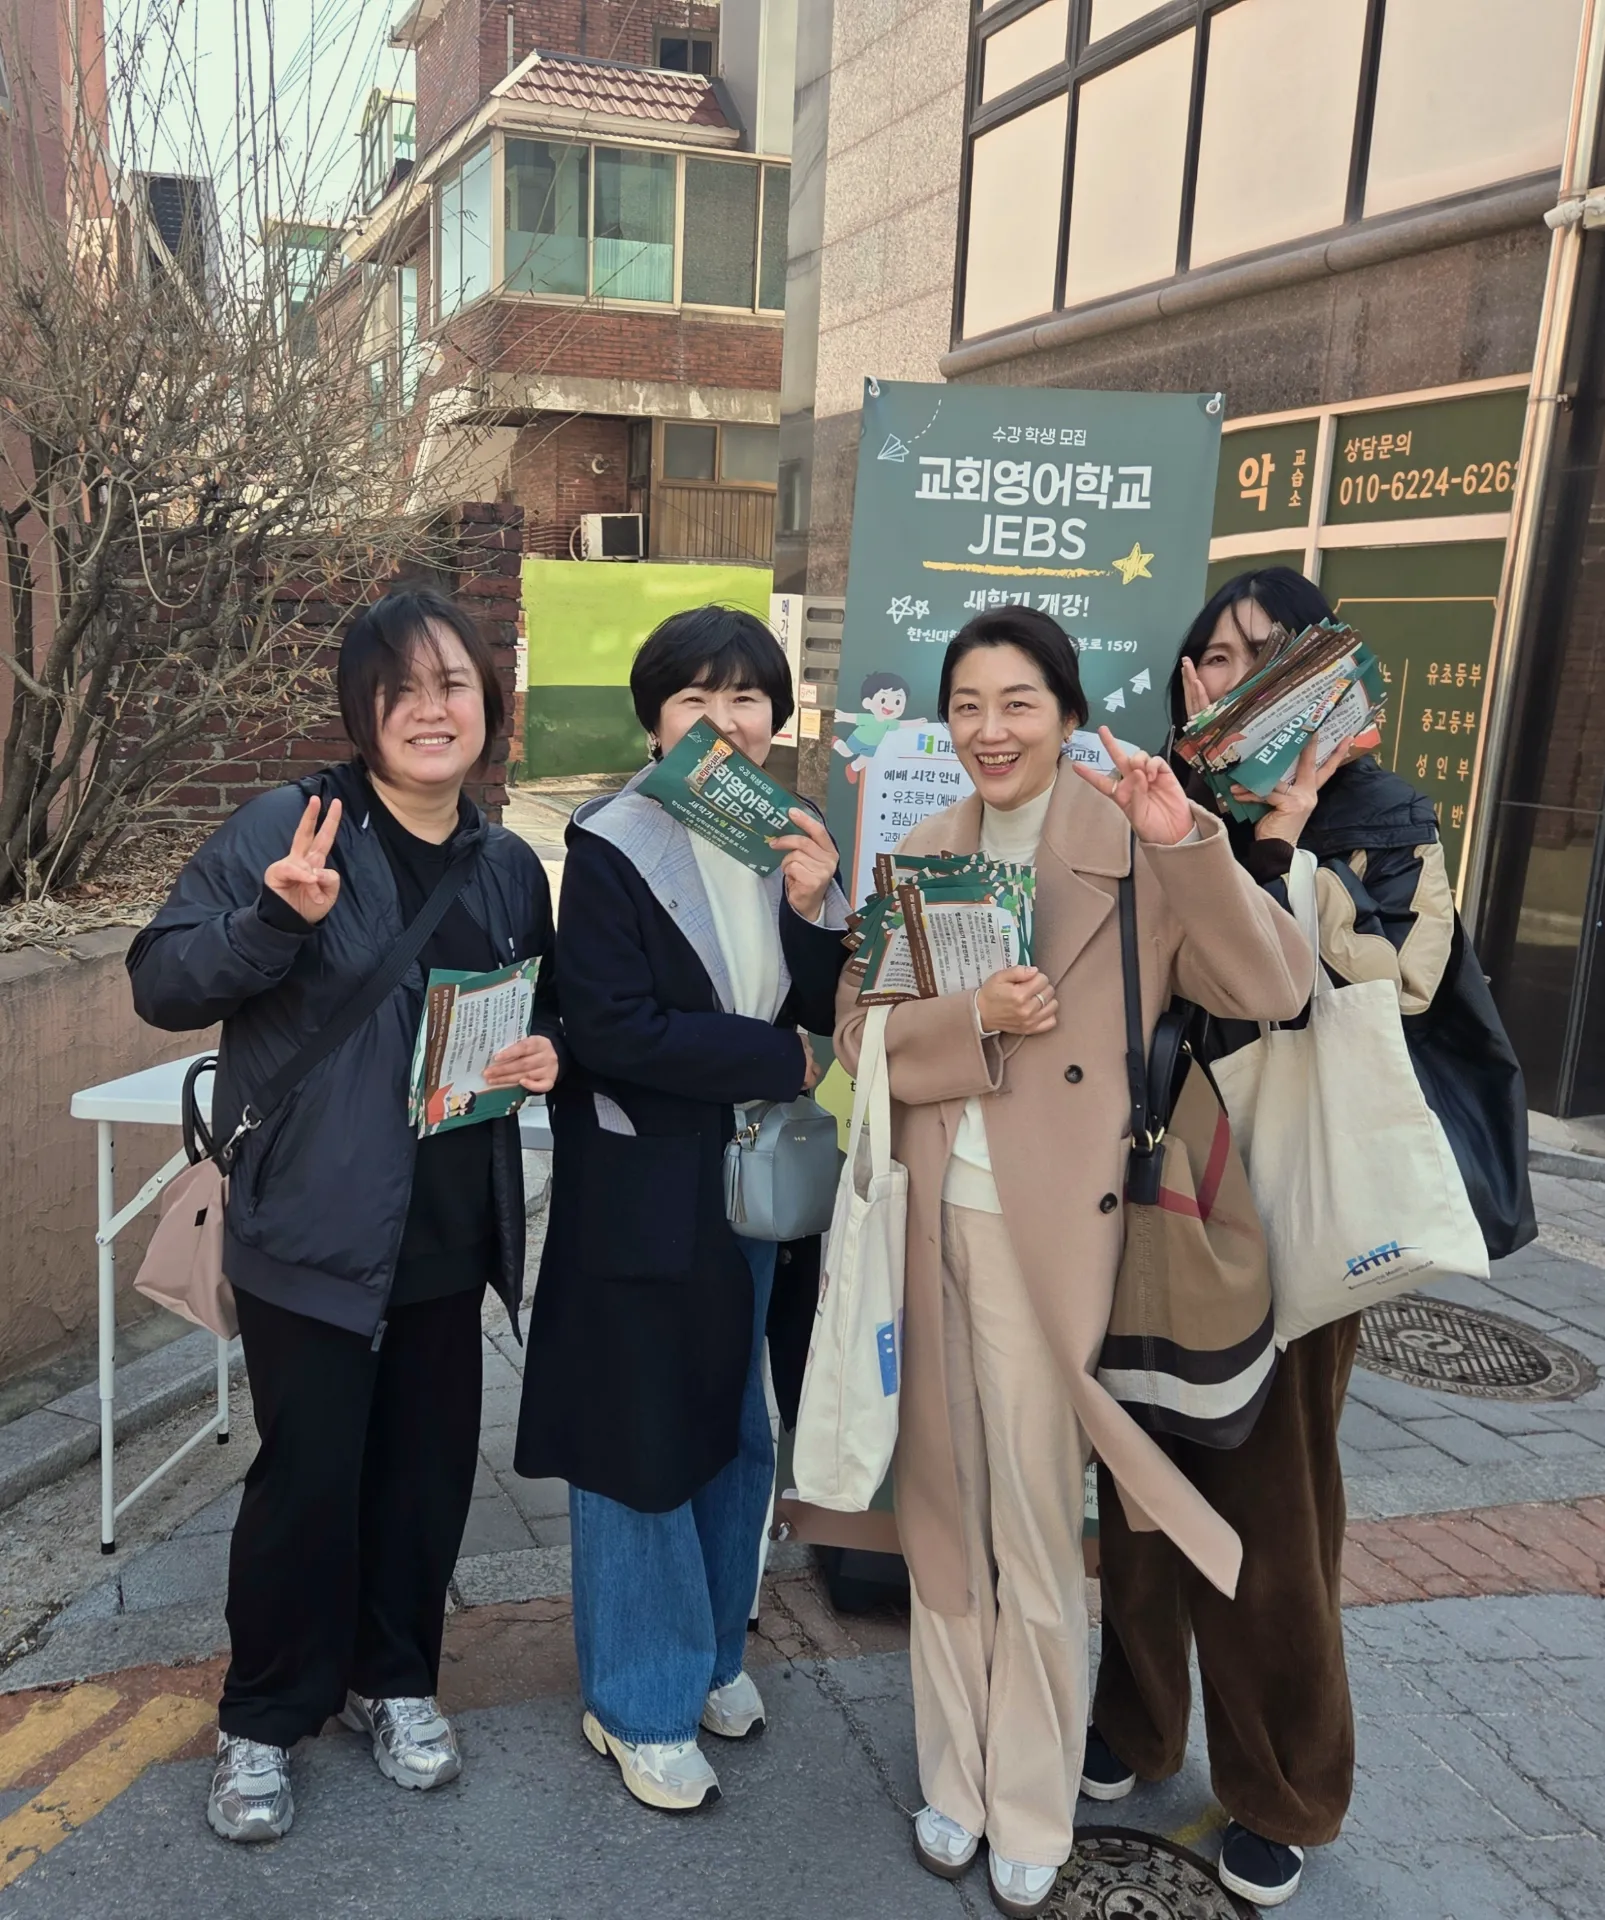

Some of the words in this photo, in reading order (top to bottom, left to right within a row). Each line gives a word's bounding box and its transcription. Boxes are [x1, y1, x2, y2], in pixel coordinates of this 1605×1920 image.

[992, 426, 1022, 444] 수강
[1025, 426, 1056, 445] 학생
[1059, 429, 1087, 446] 모집
[1344, 431, 1412, 463] 상담문의
[915, 456, 1152, 510] 교회영어학교
[1238, 453, 1275, 511] 악
[1288, 449, 1306, 507] 교습소
[967, 514, 1087, 560] JEBS
[963, 588, 1031, 611] 새학기
[1038, 593, 1089, 617] 개강!
[1107, 640, 1138, 653] 159)
[1426, 662, 1481, 687] 유초등부
[1421, 708, 1475, 734] 중고등부
[884, 769, 908, 781] 예배
[911, 769, 936, 783] 시간
[939, 772, 960, 785] 안내
[704, 787, 755, 825] JEBS
[893, 790, 935, 806] 유초등부
[937, 793, 957, 807] 예배
